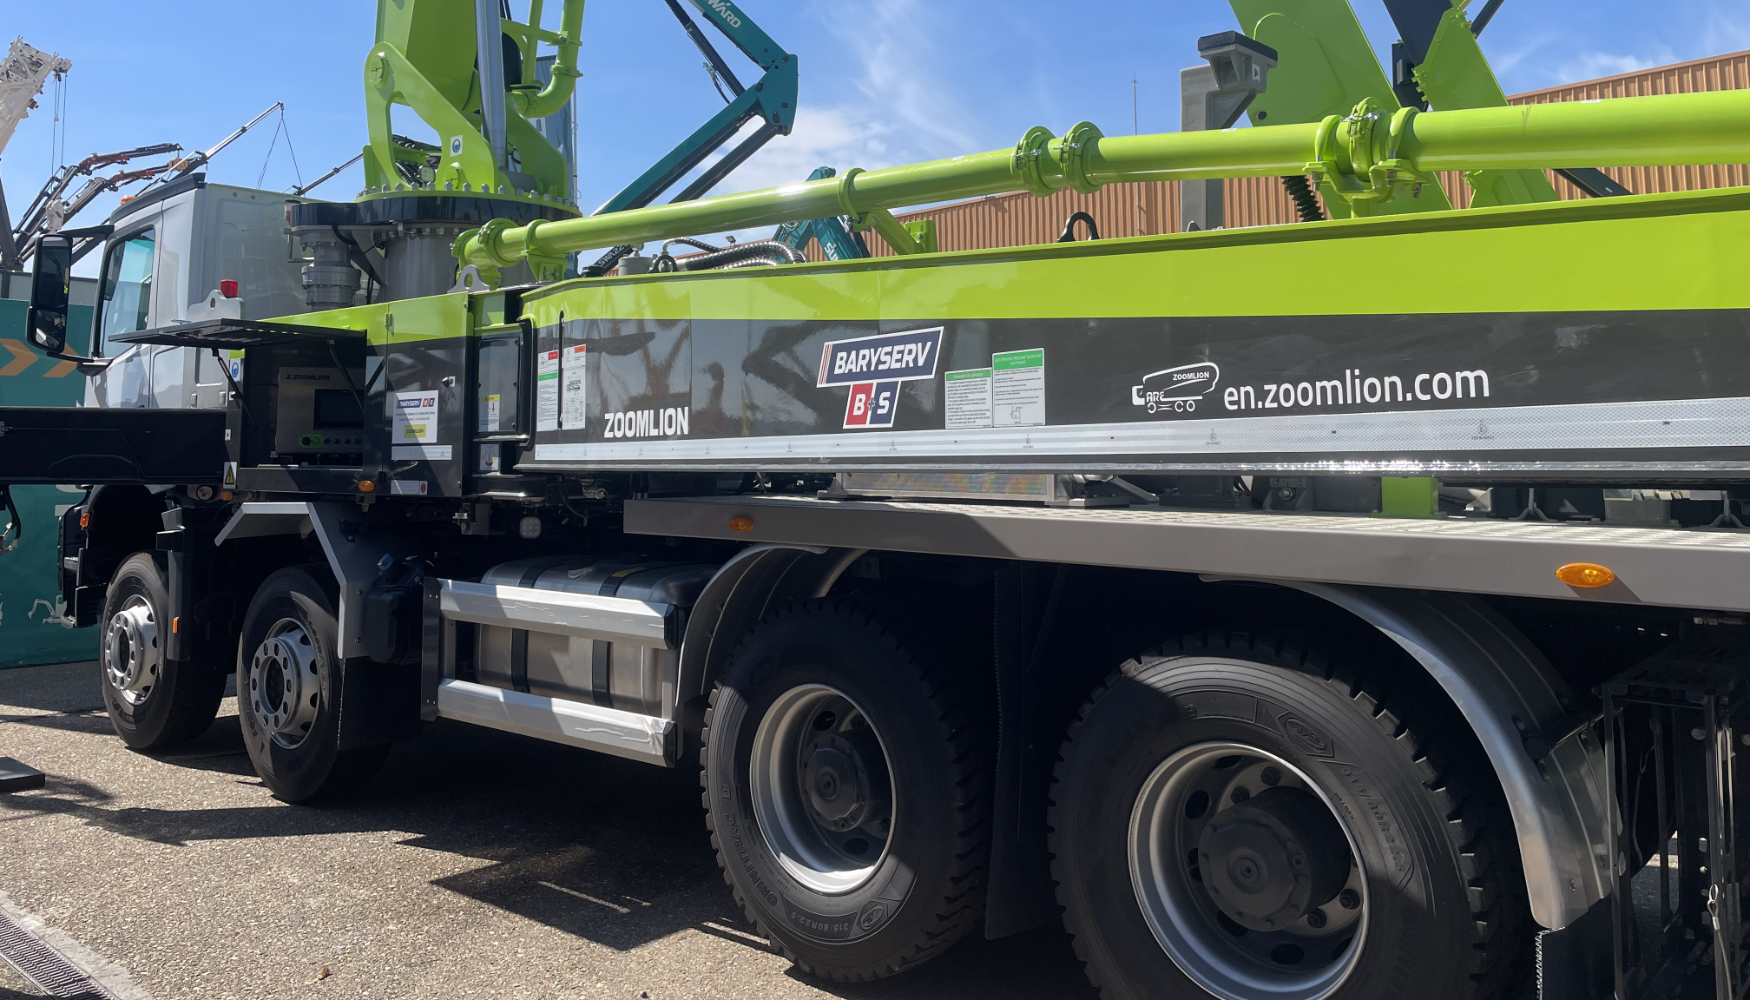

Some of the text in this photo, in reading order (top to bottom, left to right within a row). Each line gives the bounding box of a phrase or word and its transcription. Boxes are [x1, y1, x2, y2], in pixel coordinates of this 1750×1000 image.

[704, 0, 742, 28] WARD
[833, 341, 932, 375] BARYSERV
[1172, 371, 1210, 381] ZOOMLION
[1224, 369, 1490, 411] en.zoomlion.com
[603, 406, 689, 438] ZOOMLION
[725, 811, 778, 907] OMNITRAC
